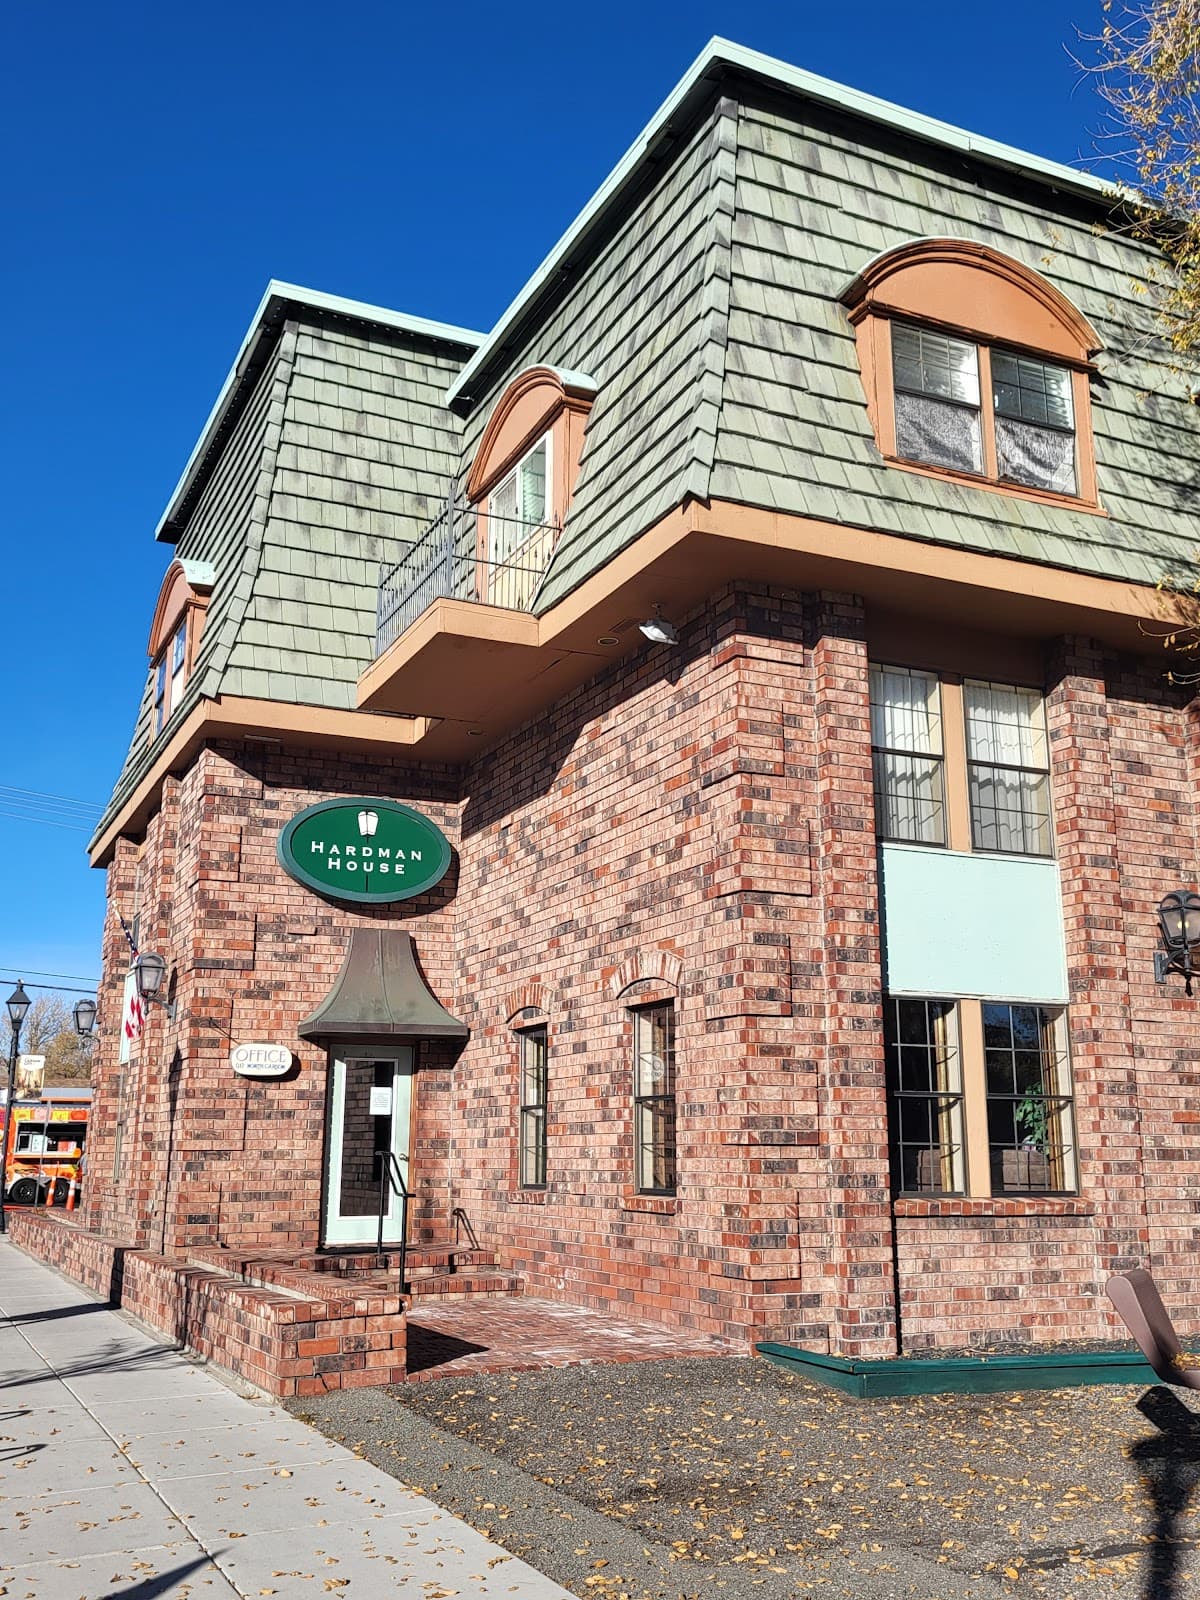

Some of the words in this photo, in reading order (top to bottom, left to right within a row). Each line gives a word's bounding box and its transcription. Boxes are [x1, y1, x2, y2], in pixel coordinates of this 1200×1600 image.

[311, 840, 422, 861] HARDMAN
[327, 857, 405, 875] HOUSE
[236, 1049, 287, 1063] OFFICE
